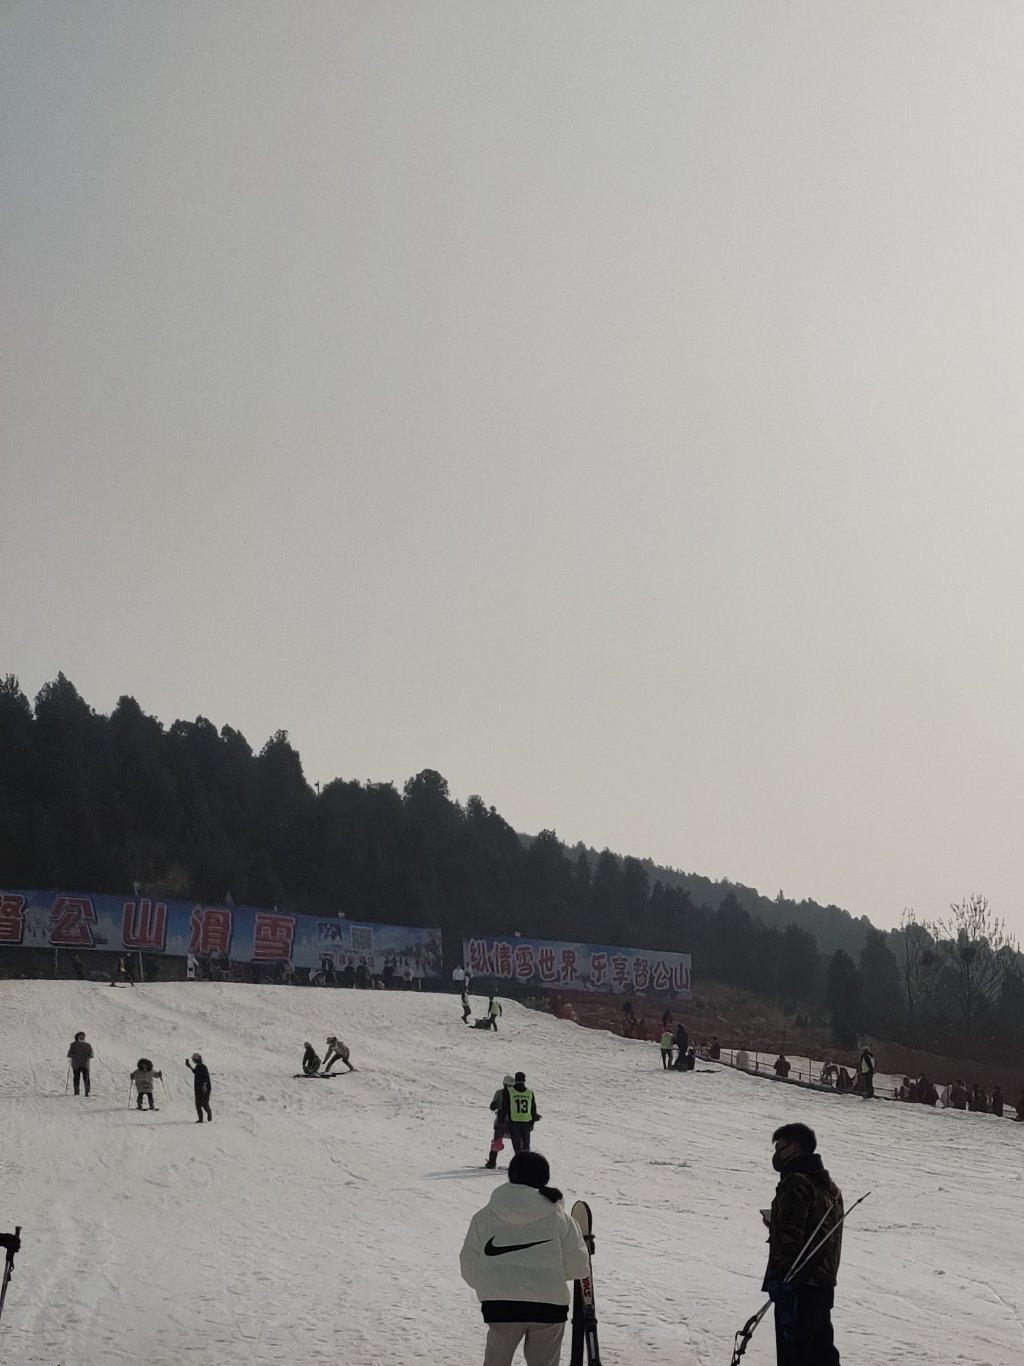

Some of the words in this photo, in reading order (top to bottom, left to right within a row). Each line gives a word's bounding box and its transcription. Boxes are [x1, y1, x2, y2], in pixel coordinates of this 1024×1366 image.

[467, 938, 578, 982] 纵情雪世界
[512, 1099, 528, 1114] 13
